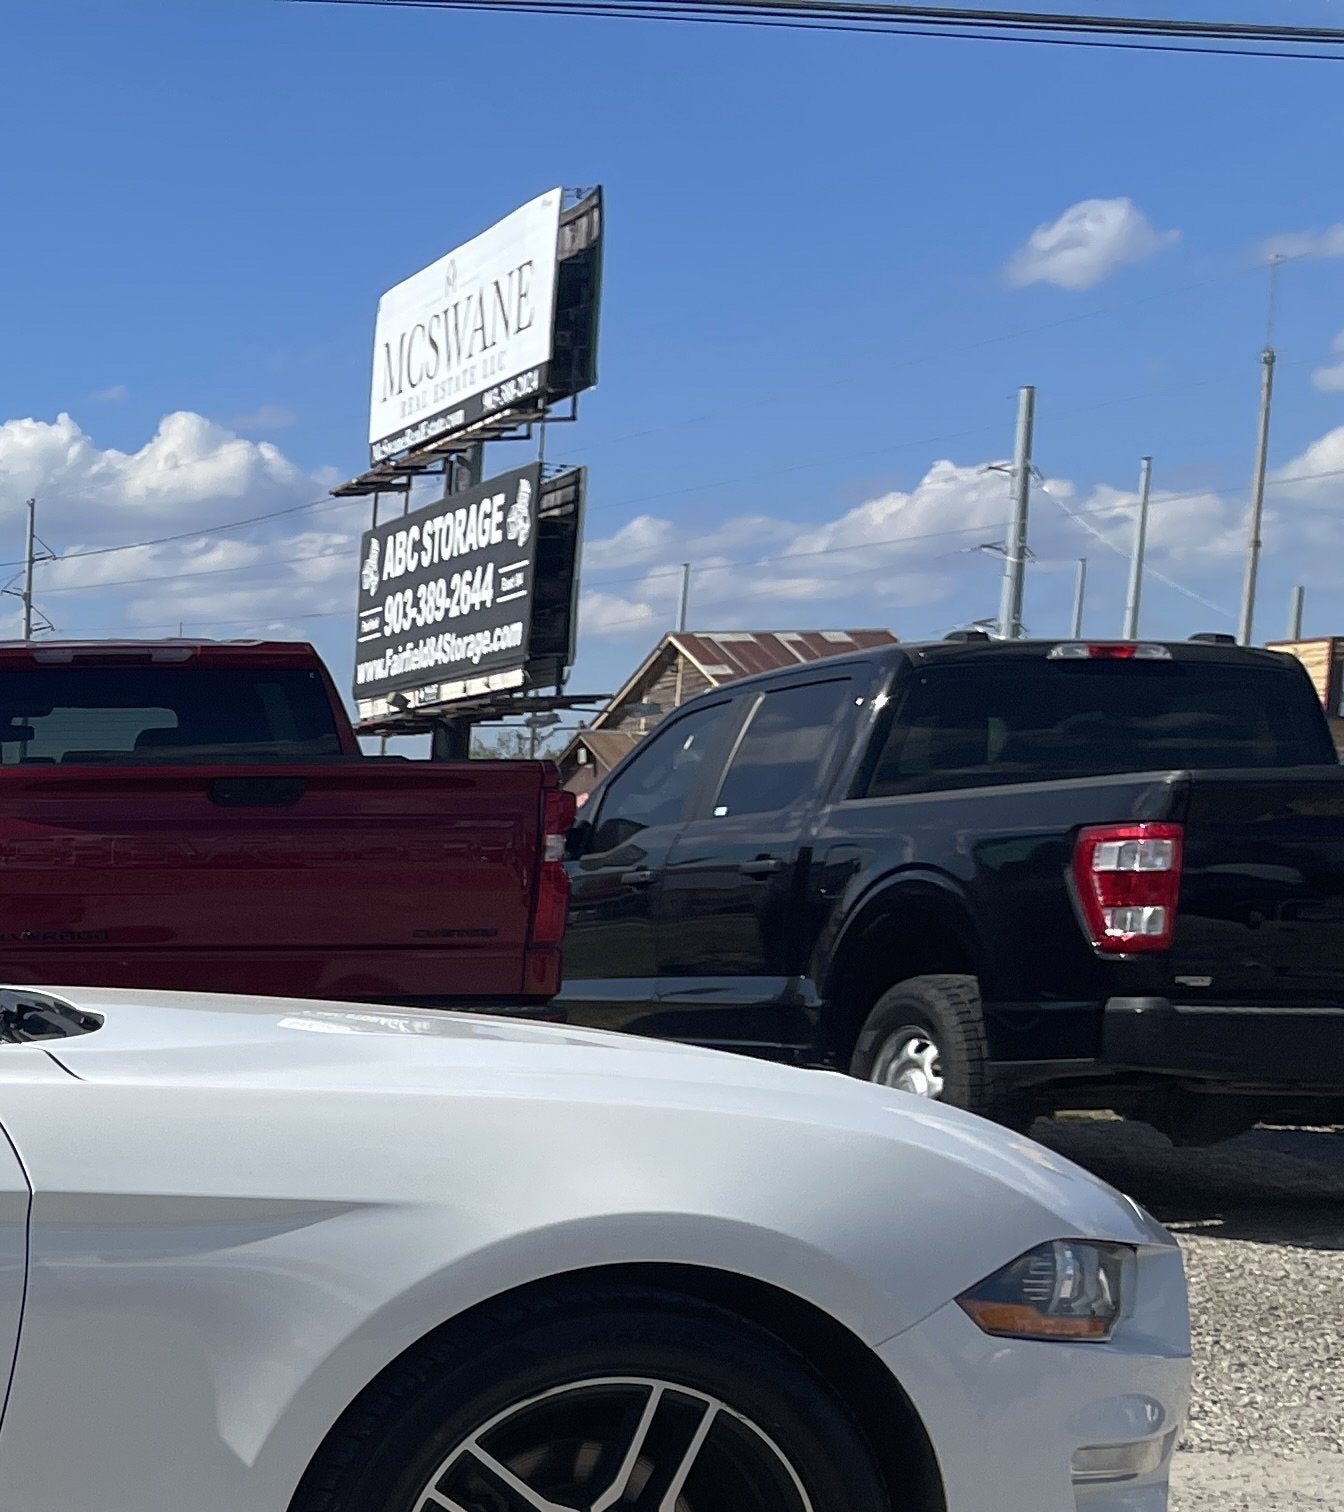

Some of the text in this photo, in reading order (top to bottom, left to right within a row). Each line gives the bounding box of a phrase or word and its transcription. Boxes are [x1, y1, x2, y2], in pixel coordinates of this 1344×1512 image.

[381, 260, 534, 403] MCSWANE
[382, 493, 506, 580] ABC STORAGE
[384, 562, 494, 637] 903-389-2644
[356, 621, 523, 684] www.Fairfield84Storage.com
